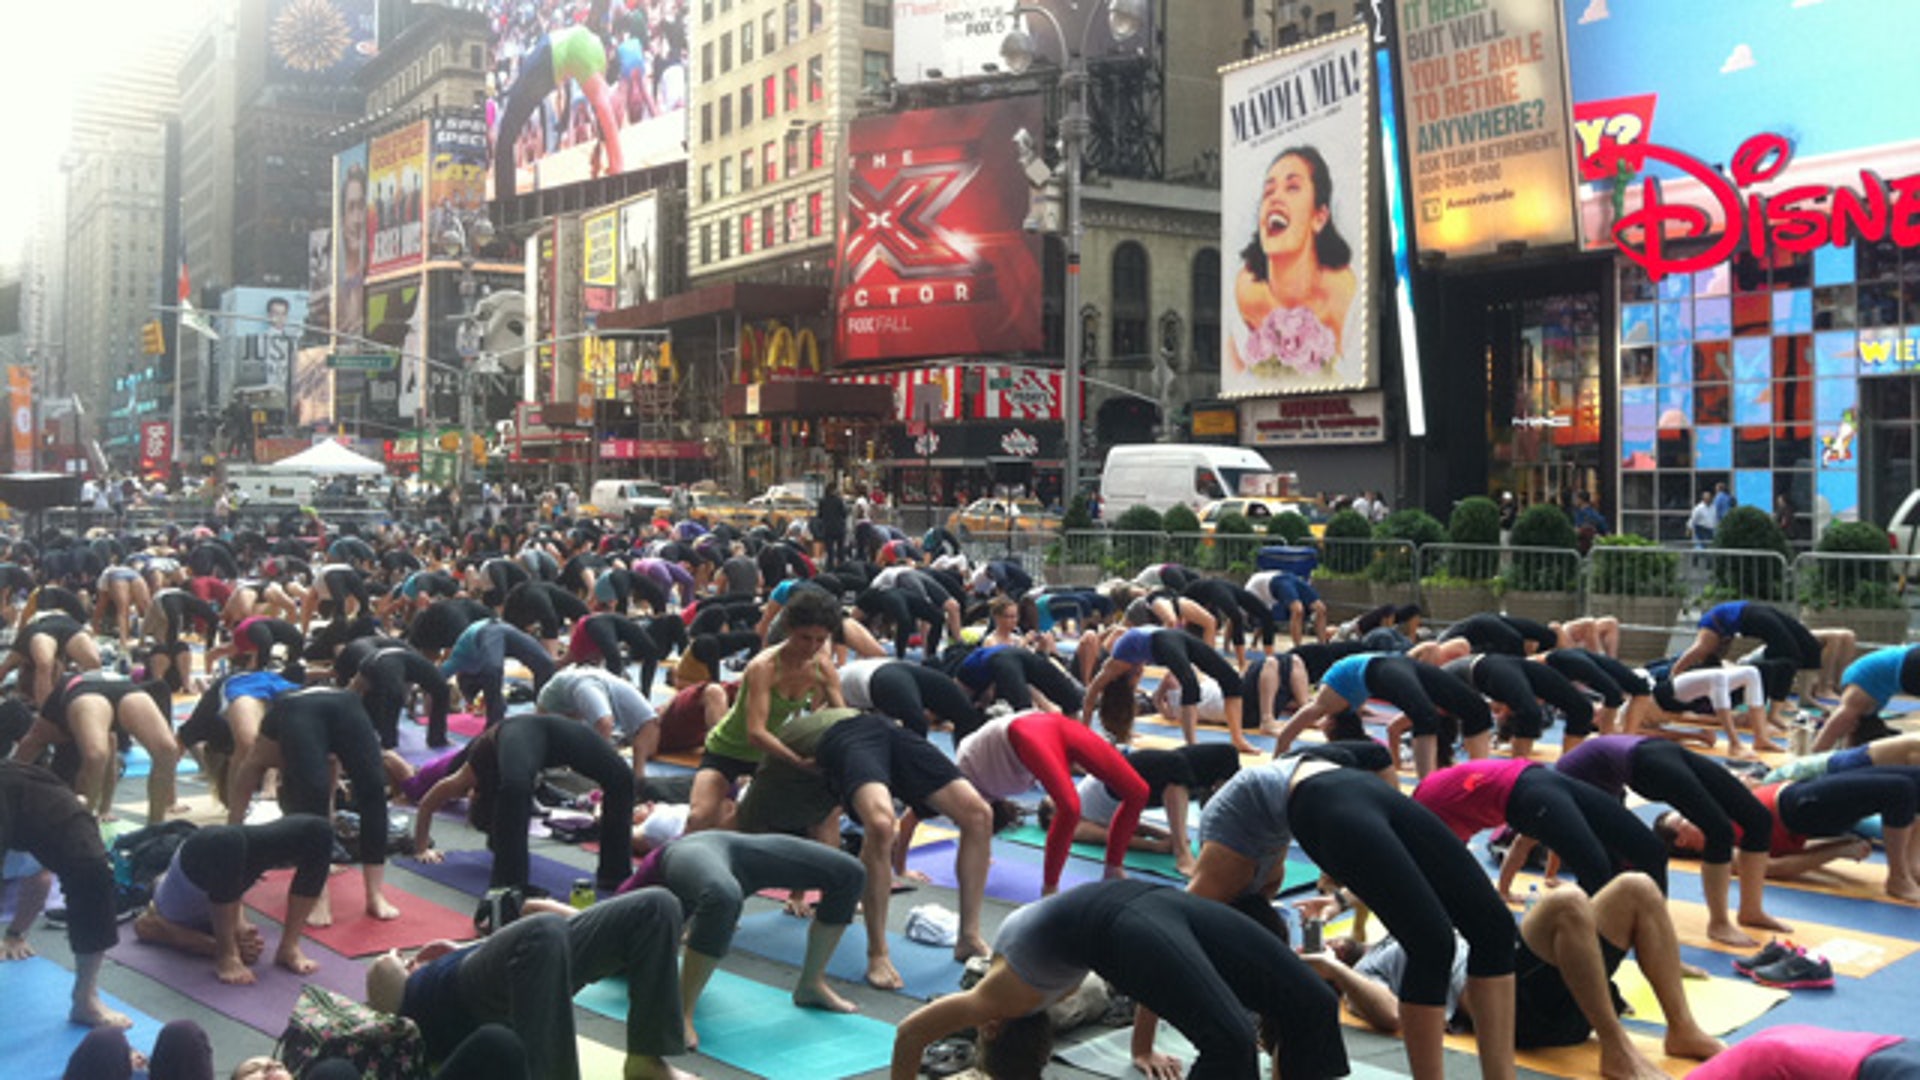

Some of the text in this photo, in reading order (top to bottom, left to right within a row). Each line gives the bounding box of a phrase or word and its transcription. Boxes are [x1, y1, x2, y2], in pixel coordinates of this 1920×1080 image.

[965, 21, 993, 37] FOX
[995, 20, 1005, 34] 5
[1406, 9, 1504, 60] BUT WILL
[1411, 32, 1544, 91] YOU BE ABLE
[1230, 75, 1307, 141] MAMMA
[1310, 49, 1360, 106] MIA!
[1413, 71, 1520, 121] TO RETIRE
[1417, 98, 1545, 153] ANYWHERE?
